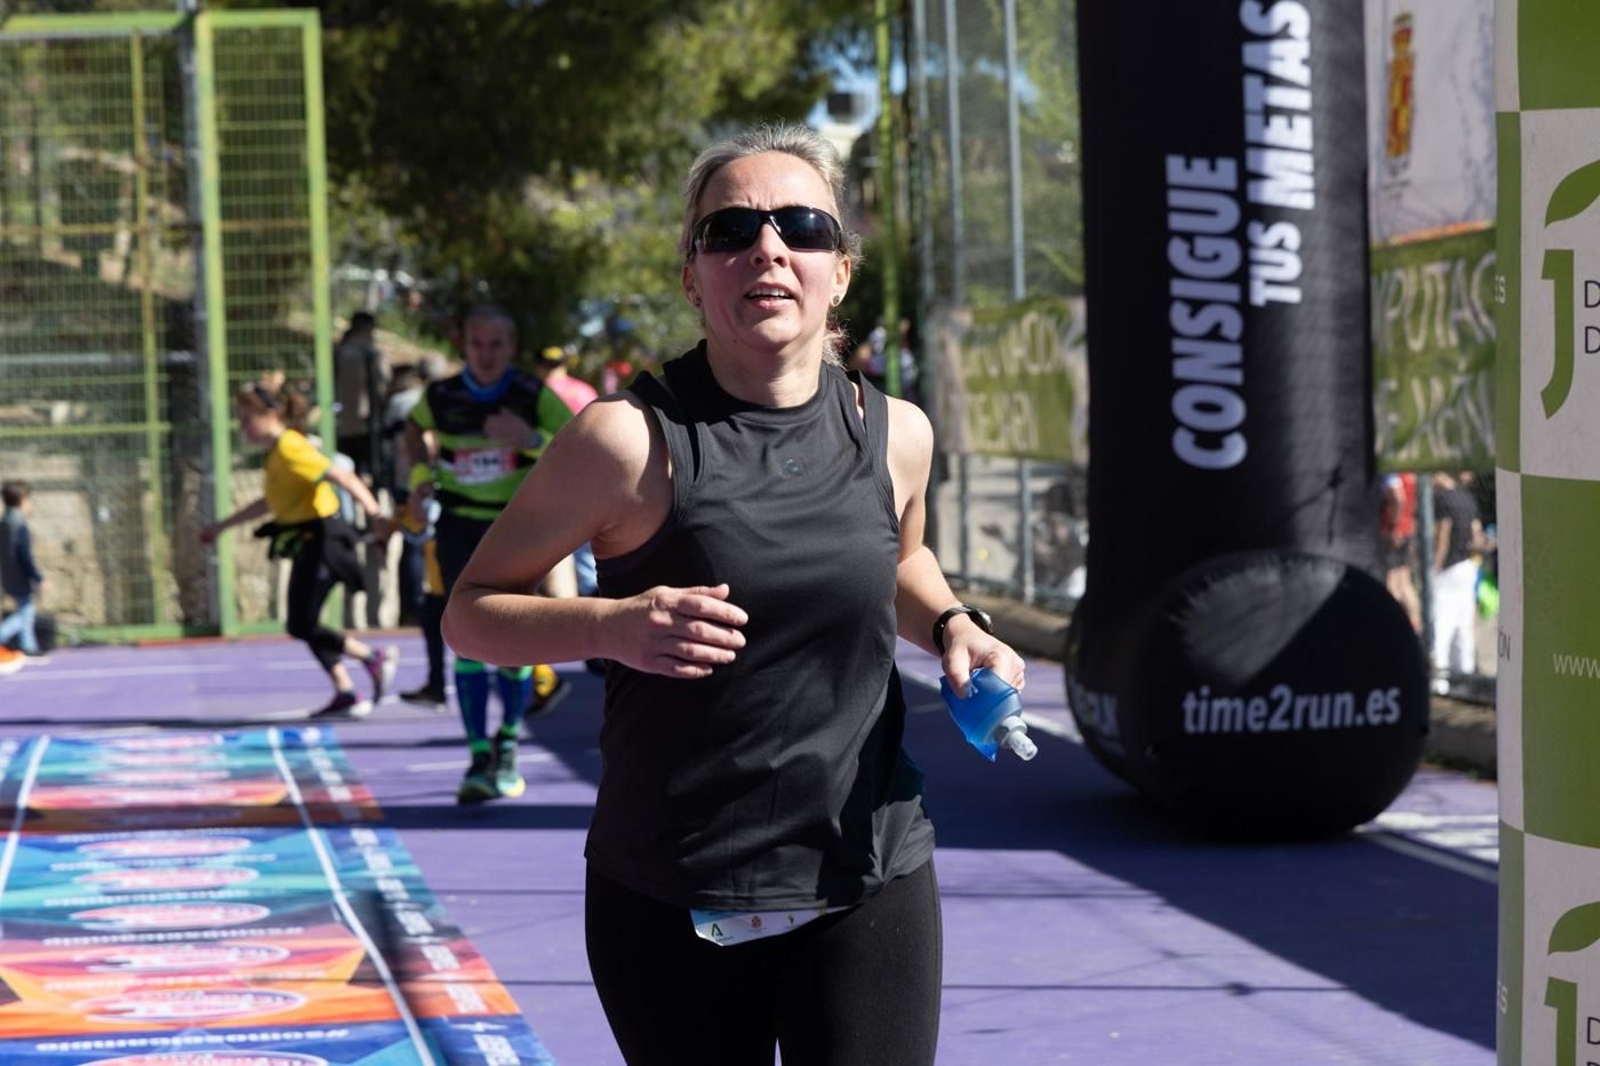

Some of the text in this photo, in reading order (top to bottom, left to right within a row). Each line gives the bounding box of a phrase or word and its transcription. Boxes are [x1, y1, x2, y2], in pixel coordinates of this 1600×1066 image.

[1238, 0, 1315, 307] TUS METAS
[1165, 154, 1248, 470] CONSIGUE
[1182, 684, 1401, 734] time2run.es
